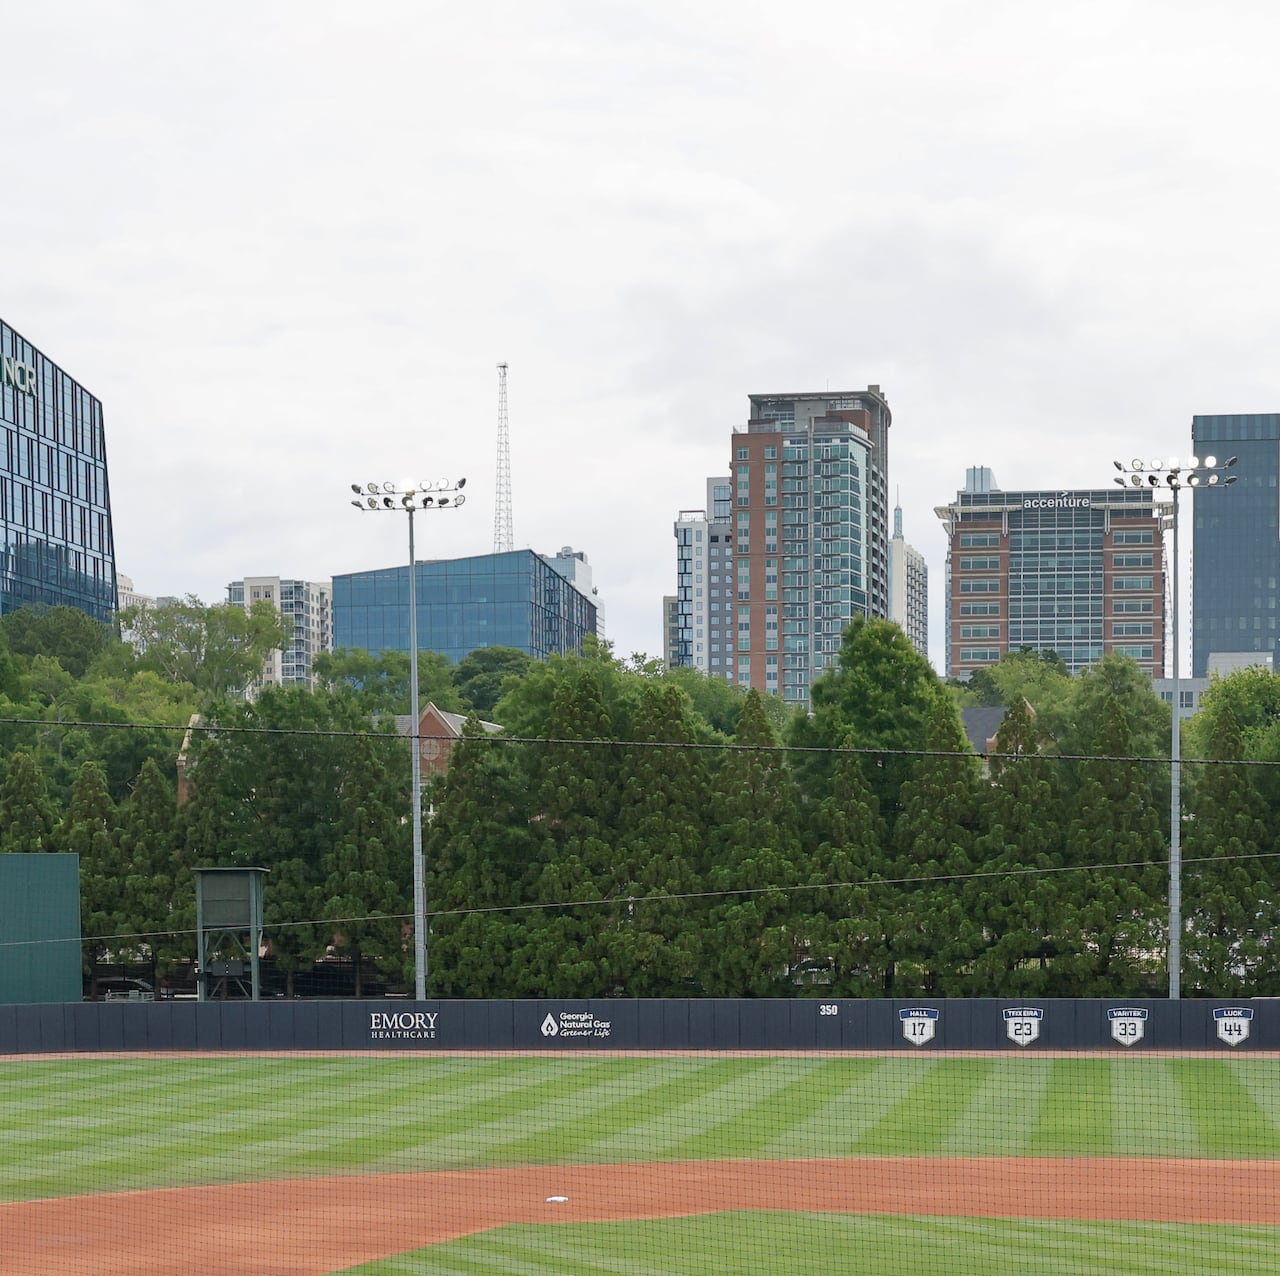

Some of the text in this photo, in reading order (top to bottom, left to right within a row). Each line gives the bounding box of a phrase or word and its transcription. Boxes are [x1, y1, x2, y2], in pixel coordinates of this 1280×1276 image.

[1, 353, 37, 397] NCR
[1023, 495, 1090, 509] accenture
[560, 1012, 594, 1022] Georgia
[819, 1005, 838, 1016] 350
[370, 1013, 439, 1029] EMORY
[560, 1020, 611, 1029] Natural Gas
[371, 1031, 436, 1039] HEALTHCARE
[560, 1028, 592, 1037] Greener
[911, 1022, 926, 1036] 17
[1014, 1022, 1032, 1036] 23
[1118, 1022, 1137, 1036] 33
[1224, 1023, 1242, 1036] 44
